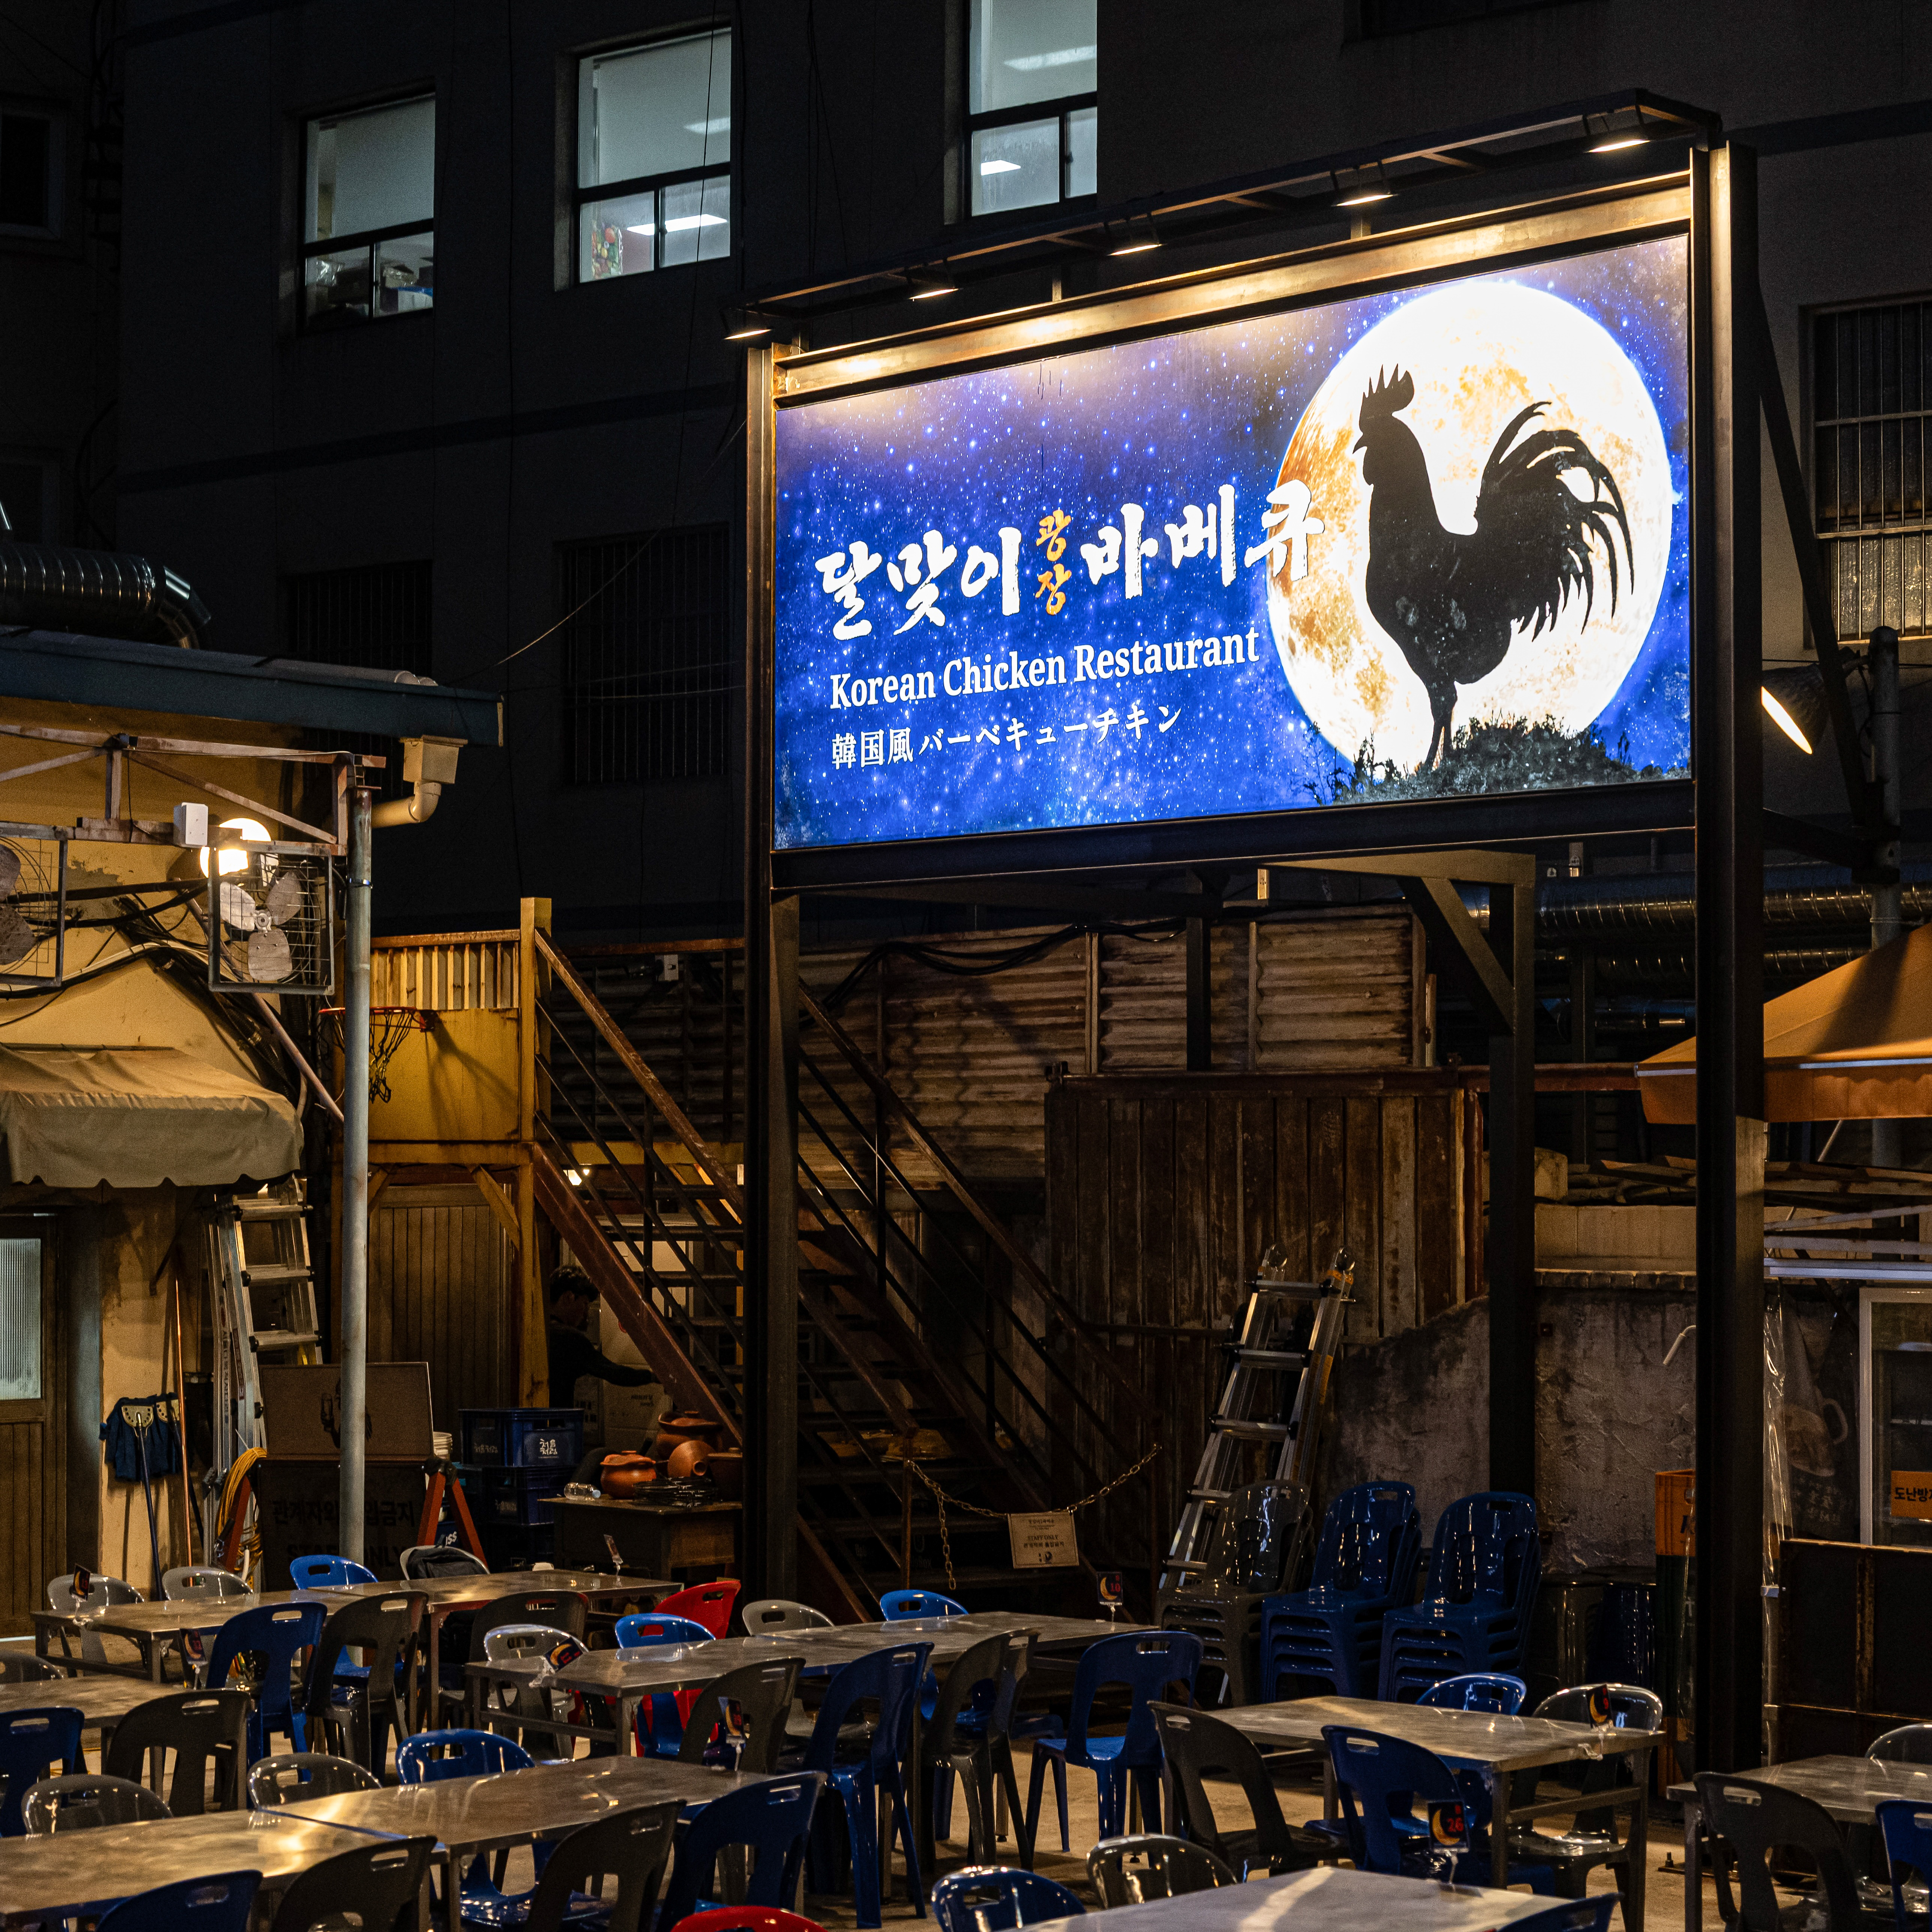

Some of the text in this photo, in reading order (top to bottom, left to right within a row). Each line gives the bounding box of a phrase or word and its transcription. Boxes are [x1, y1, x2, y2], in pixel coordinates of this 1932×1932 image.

[815, 527, 1022, 640] 달맞이
[1080, 479, 1325, 599] 바베큐
[830, 626, 1260, 709] Korean Chicken Restaurant
[364, 1500, 415, 1527] 입금지
[364, 1545, 406, 1567] NLY
[1110, 1582, 1121, 1592] 10
[1447, 1817, 1464, 1833] 26
